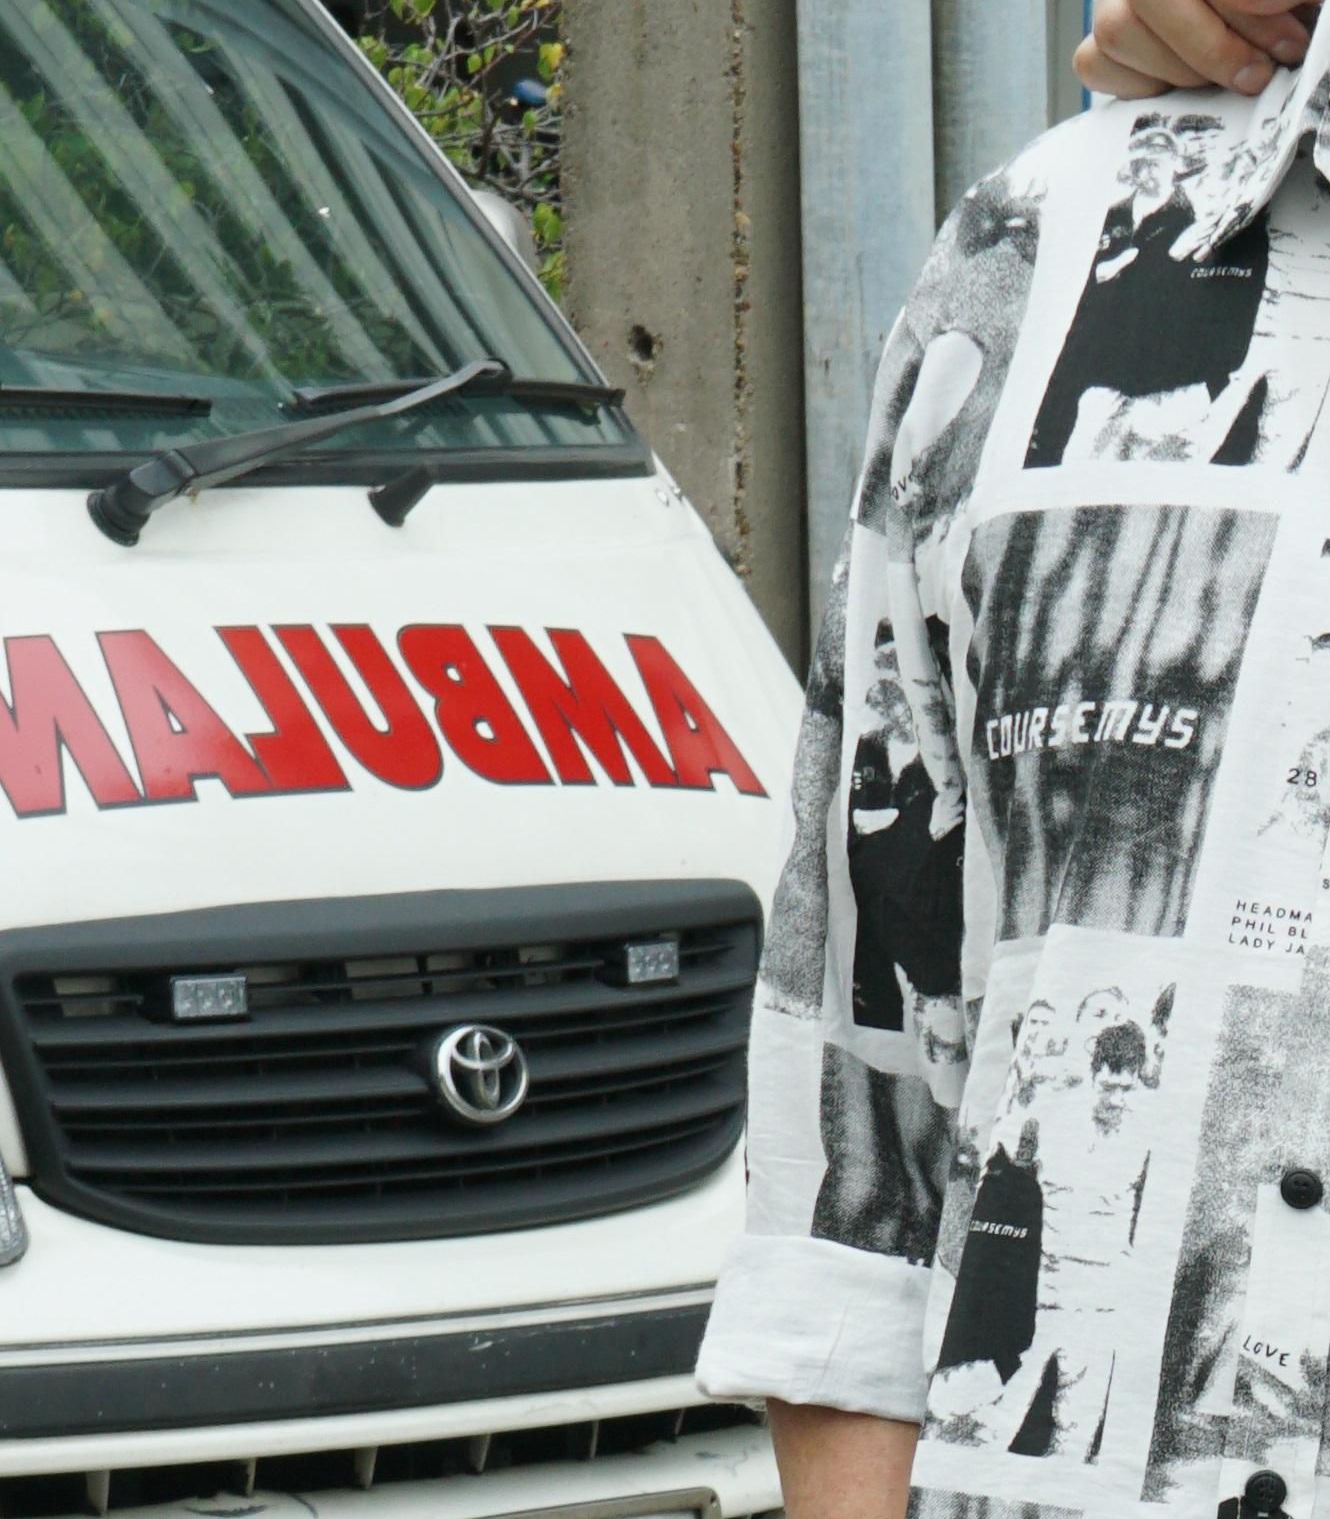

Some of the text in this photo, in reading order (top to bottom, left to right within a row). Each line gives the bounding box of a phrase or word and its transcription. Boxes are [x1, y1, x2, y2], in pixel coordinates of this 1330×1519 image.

[986, 700, 1199, 761] COURSEMYS
[1286, 767, 1318, 788] 28
[1235, 899, 1313, 922] HEADMA
[1231, 915, 1276, 934] PHIL
[1228, 932, 1276, 951] LADY
[1242, 1334, 1291, 1368] LOVE
